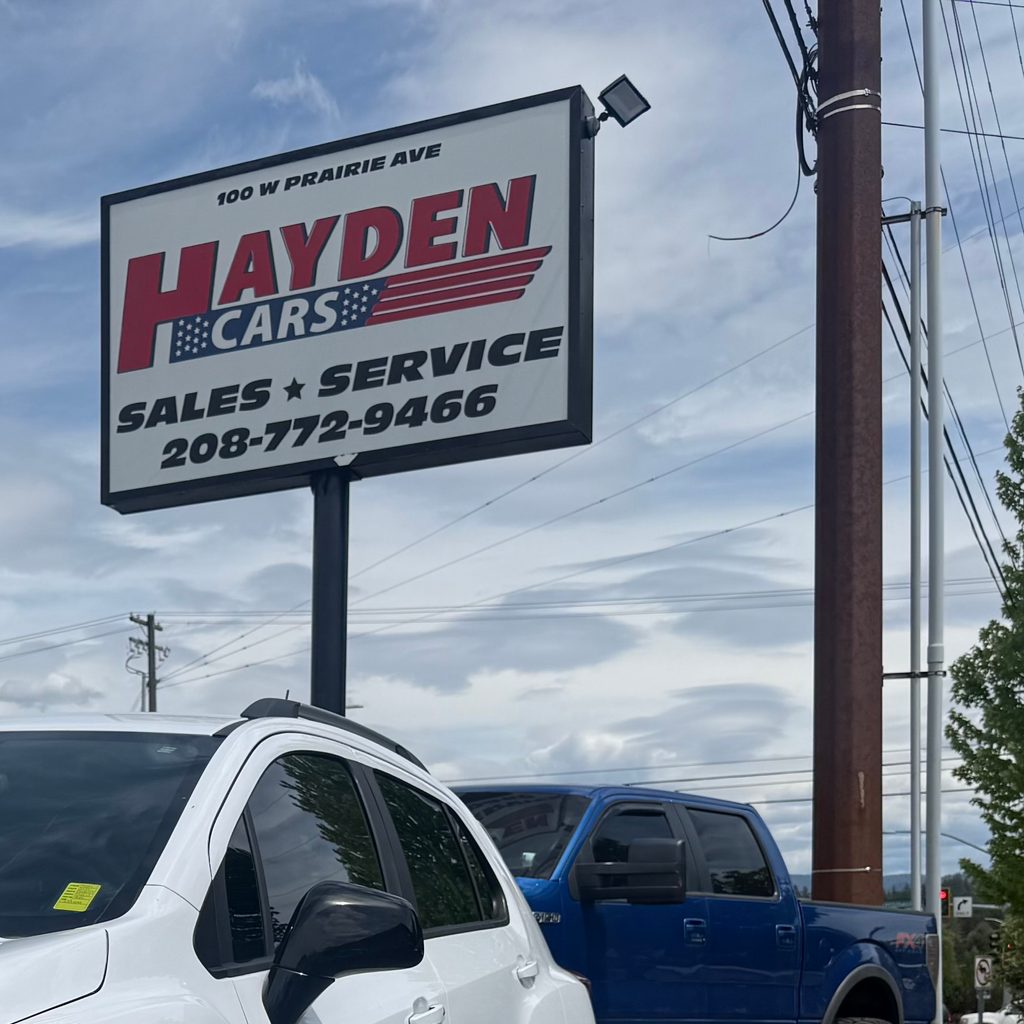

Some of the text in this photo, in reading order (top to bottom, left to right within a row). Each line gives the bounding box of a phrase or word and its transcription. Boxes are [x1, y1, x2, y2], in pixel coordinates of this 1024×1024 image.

[216, 143, 442, 207] 100 W PRAIRIE AVE
[117, 174, 538, 374] HAYDEN
[211, 292, 339, 350] CARS
[116, 326, 565, 434] SALES SERVICE
[160, 384, 499, 470] 208-772-9466
